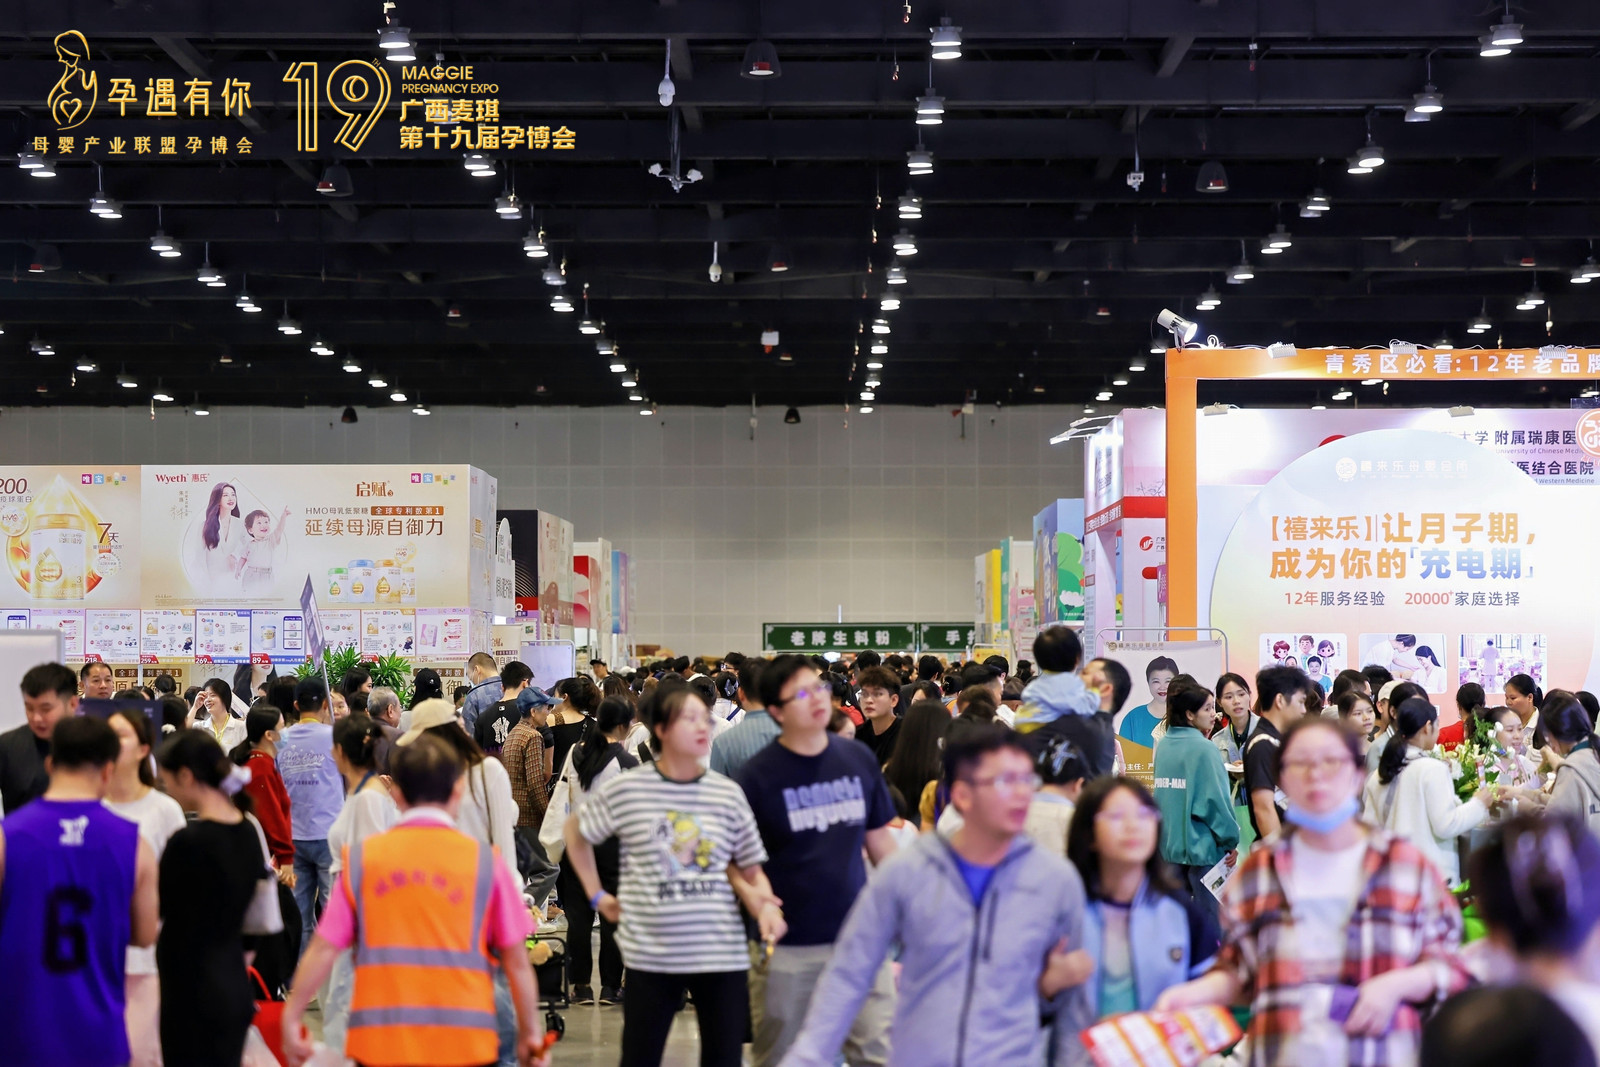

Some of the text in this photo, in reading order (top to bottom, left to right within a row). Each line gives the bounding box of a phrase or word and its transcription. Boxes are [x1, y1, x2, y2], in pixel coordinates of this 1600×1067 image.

[155, 473, 209, 484] Wyeth 惠氏
[356, 481, 388, 497] 启赋
[304, 518, 444, 537] 延续母源自御力
[1284, 591, 1385, 606] 12年服务经验
[790, 630, 891, 646] 老牌生料粉
[252, 656, 262, 664] 89
[43, 884, 92, 974] 6
